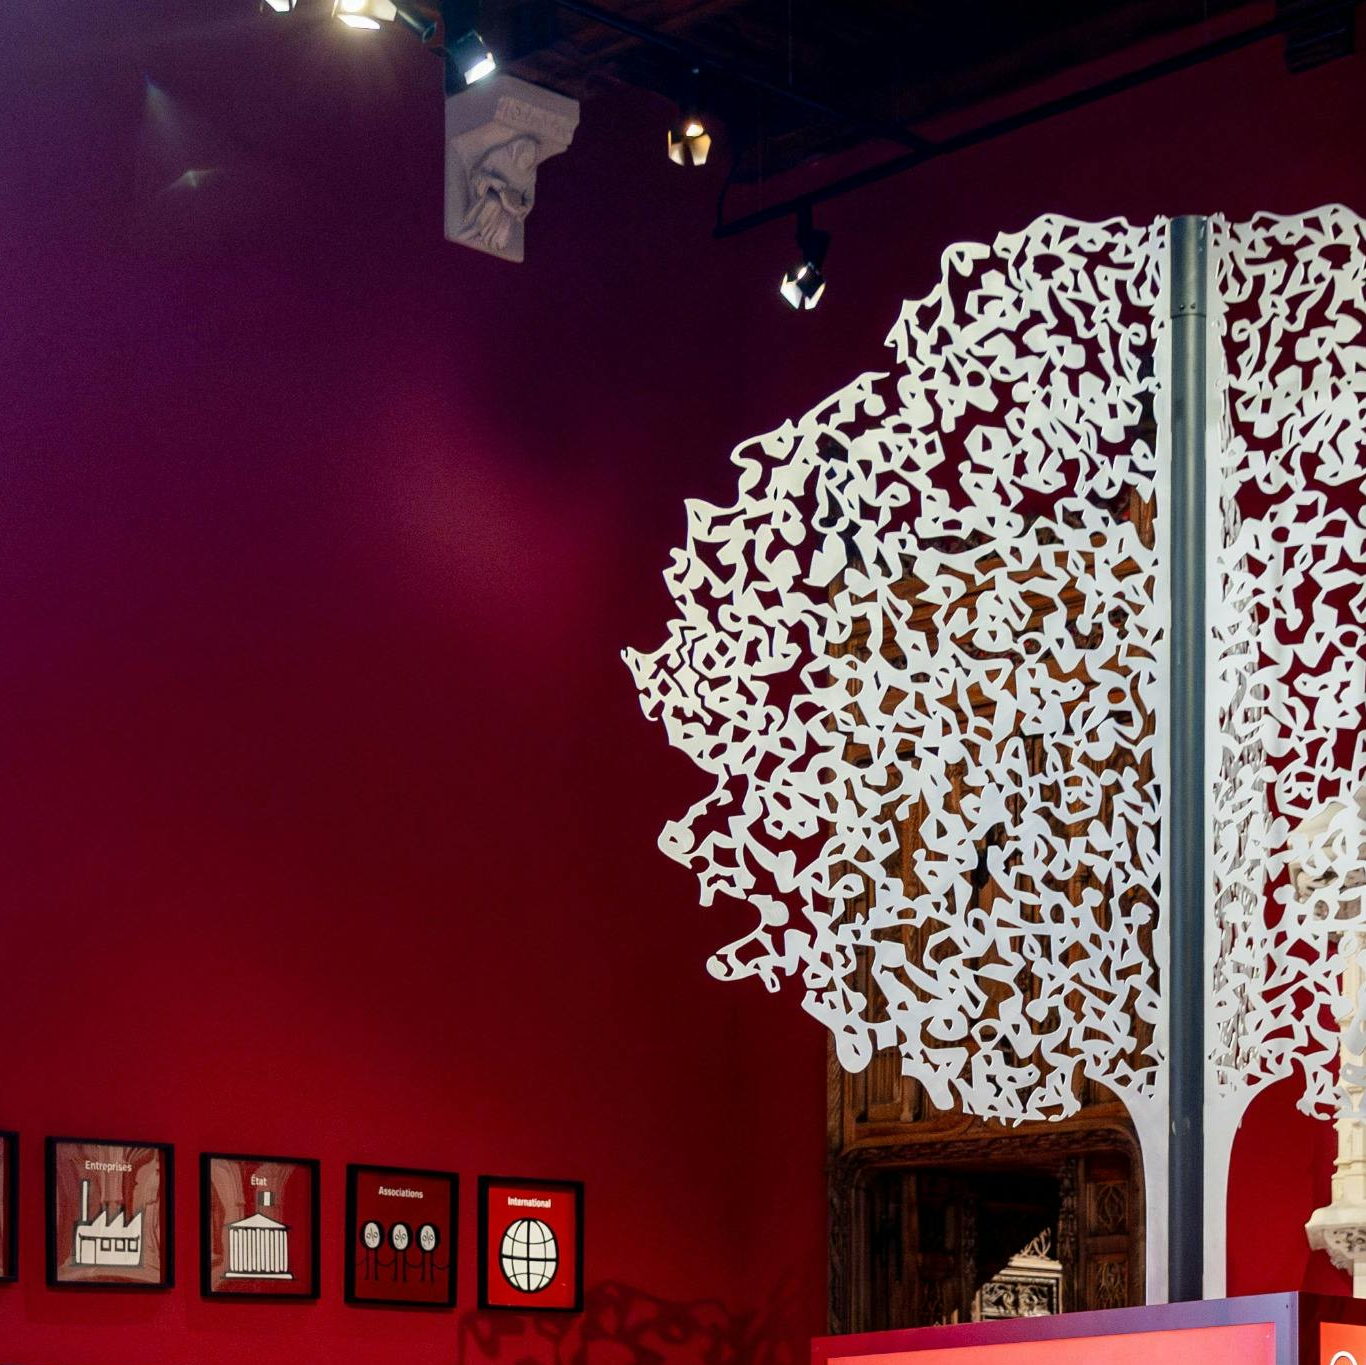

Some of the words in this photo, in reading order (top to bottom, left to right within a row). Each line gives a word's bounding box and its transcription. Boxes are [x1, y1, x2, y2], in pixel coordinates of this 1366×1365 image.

[85, 1160, 132, 1173] Entreprises
[251, 1173, 268, 1186] État
[378, 1186, 424, 1199] Associations
[508, 1196, 551, 1208] International
